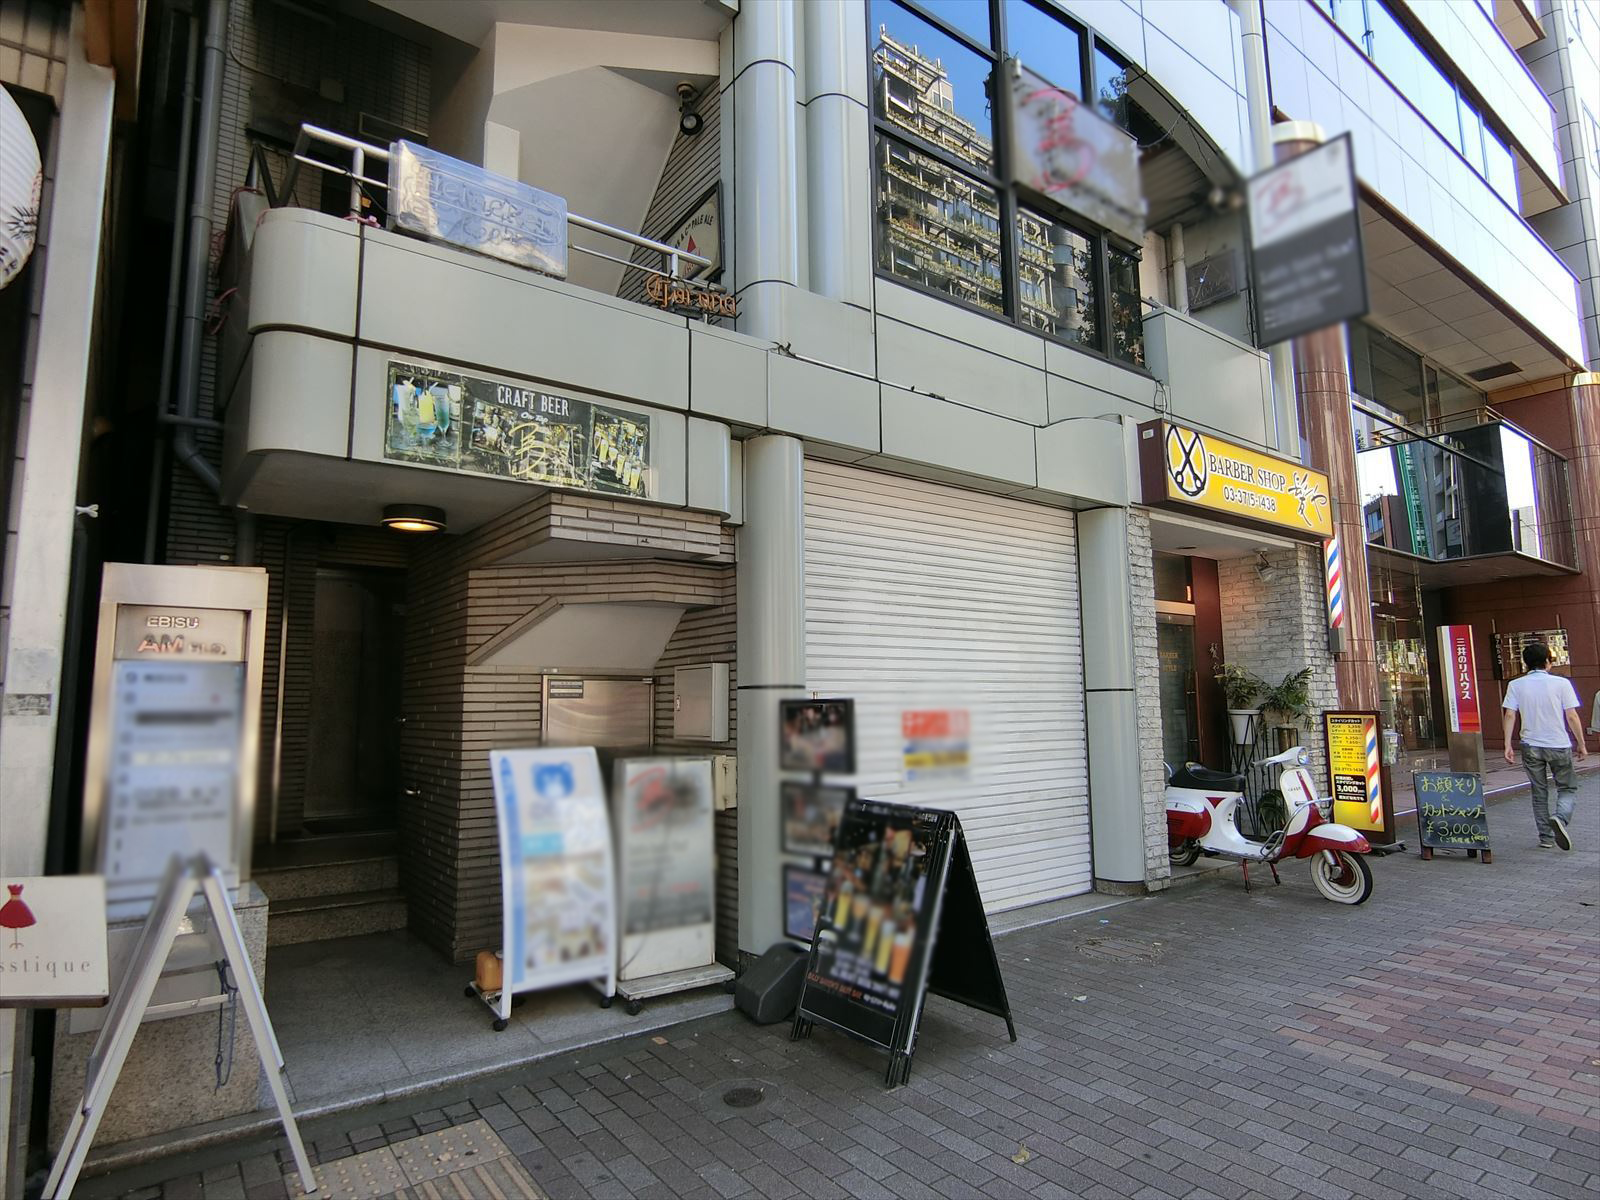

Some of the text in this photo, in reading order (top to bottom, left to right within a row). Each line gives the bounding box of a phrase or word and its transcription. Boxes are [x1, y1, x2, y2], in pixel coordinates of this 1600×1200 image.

[691, 214, 704, 230] PALE
[704, 213, 714, 226] ALE
[497, 385, 570, 417] CRAFT BEER
[1208, 454, 1286, 492] BARBER SHOP
[1223, 486, 1277, 512] 03-3715-1438
[147, 615, 199, 629] EBISU
[138, 633, 185, 654] AM
[1456, 637, 1472, 701] 三井のリハウス
[1421, 776, 1476, 796] お顔そり
